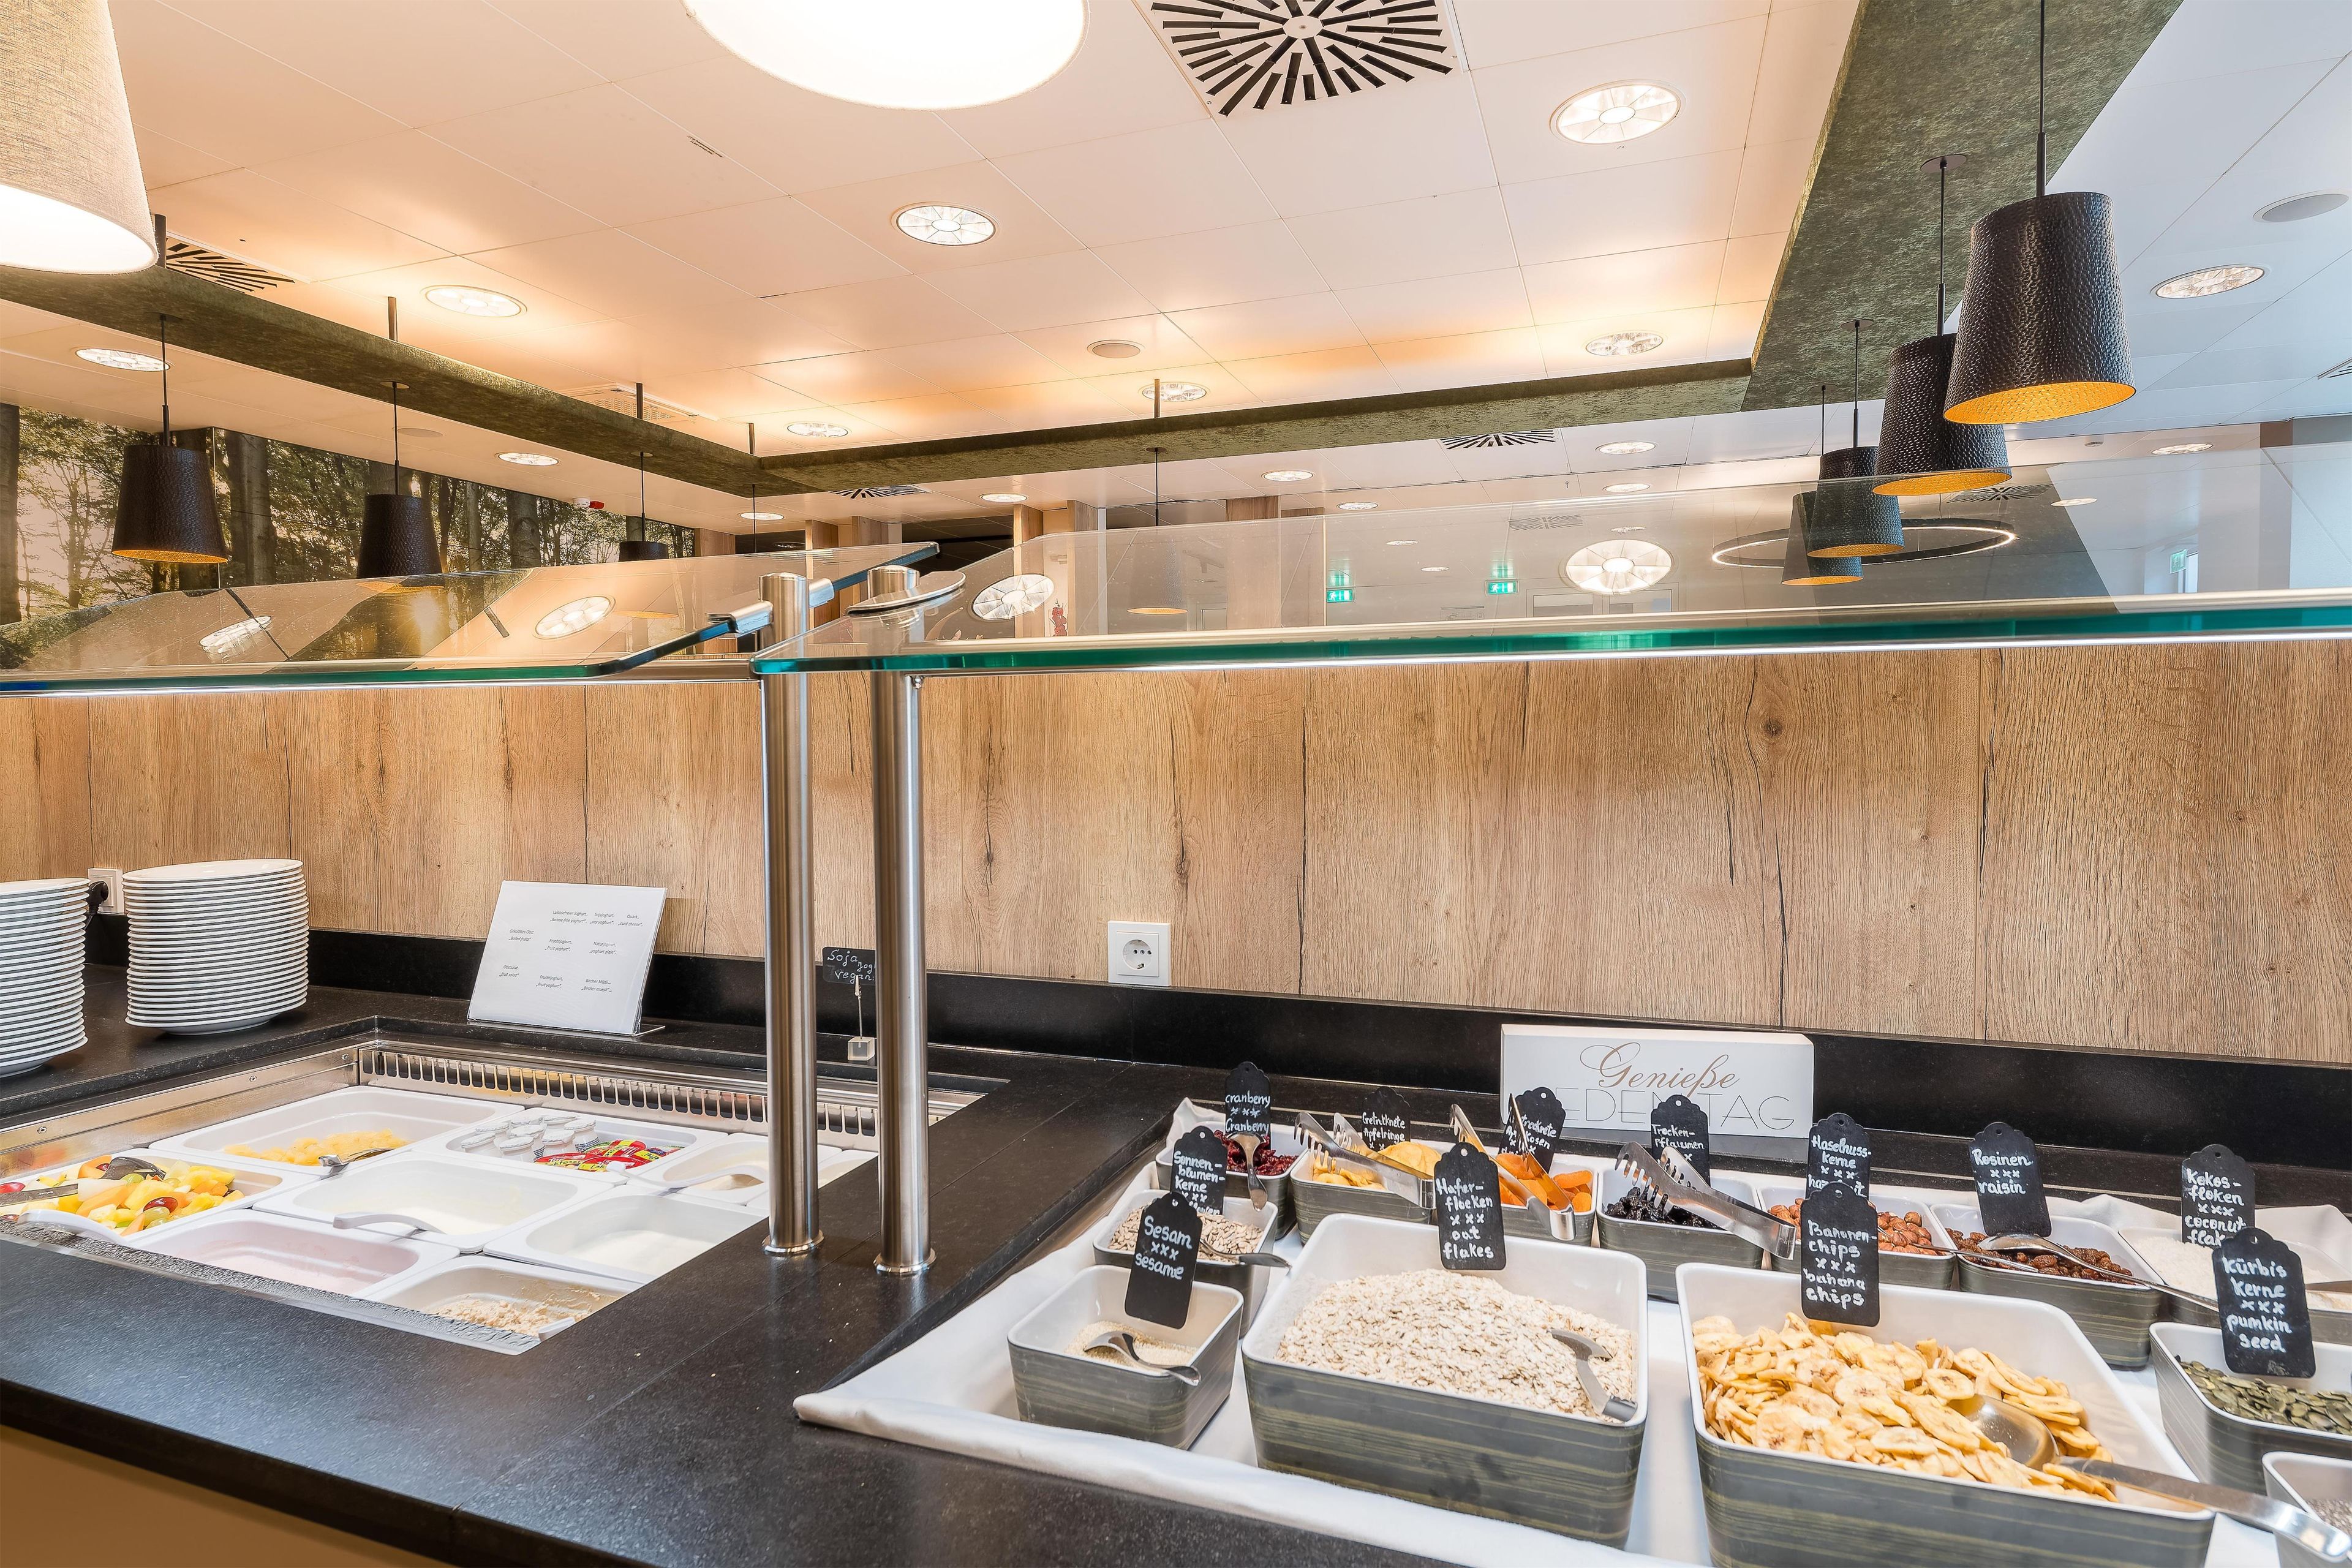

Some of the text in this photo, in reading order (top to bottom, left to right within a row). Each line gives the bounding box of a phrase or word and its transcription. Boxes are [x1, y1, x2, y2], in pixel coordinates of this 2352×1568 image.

[1580, 1042, 1741, 1098] Genieße
[1697, 1092, 1795, 1131] TAG
[1971, 1148, 2034, 1166] Rosinen
[1977, 1178, 2026, 1194] raisin
[1144, 1215, 1193, 1250] Sesam
[1452, 1226, 1481, 1241] oat
[2184, 1215, 2246, 1233] coconut
[1442, 1242, 1494, 1260] flakes
[1135, 1253, 1184, 1280] sesame
[2226, 1313, 2292, 1334] pumkin
[2239, 1333, 2286, 1353] seed
